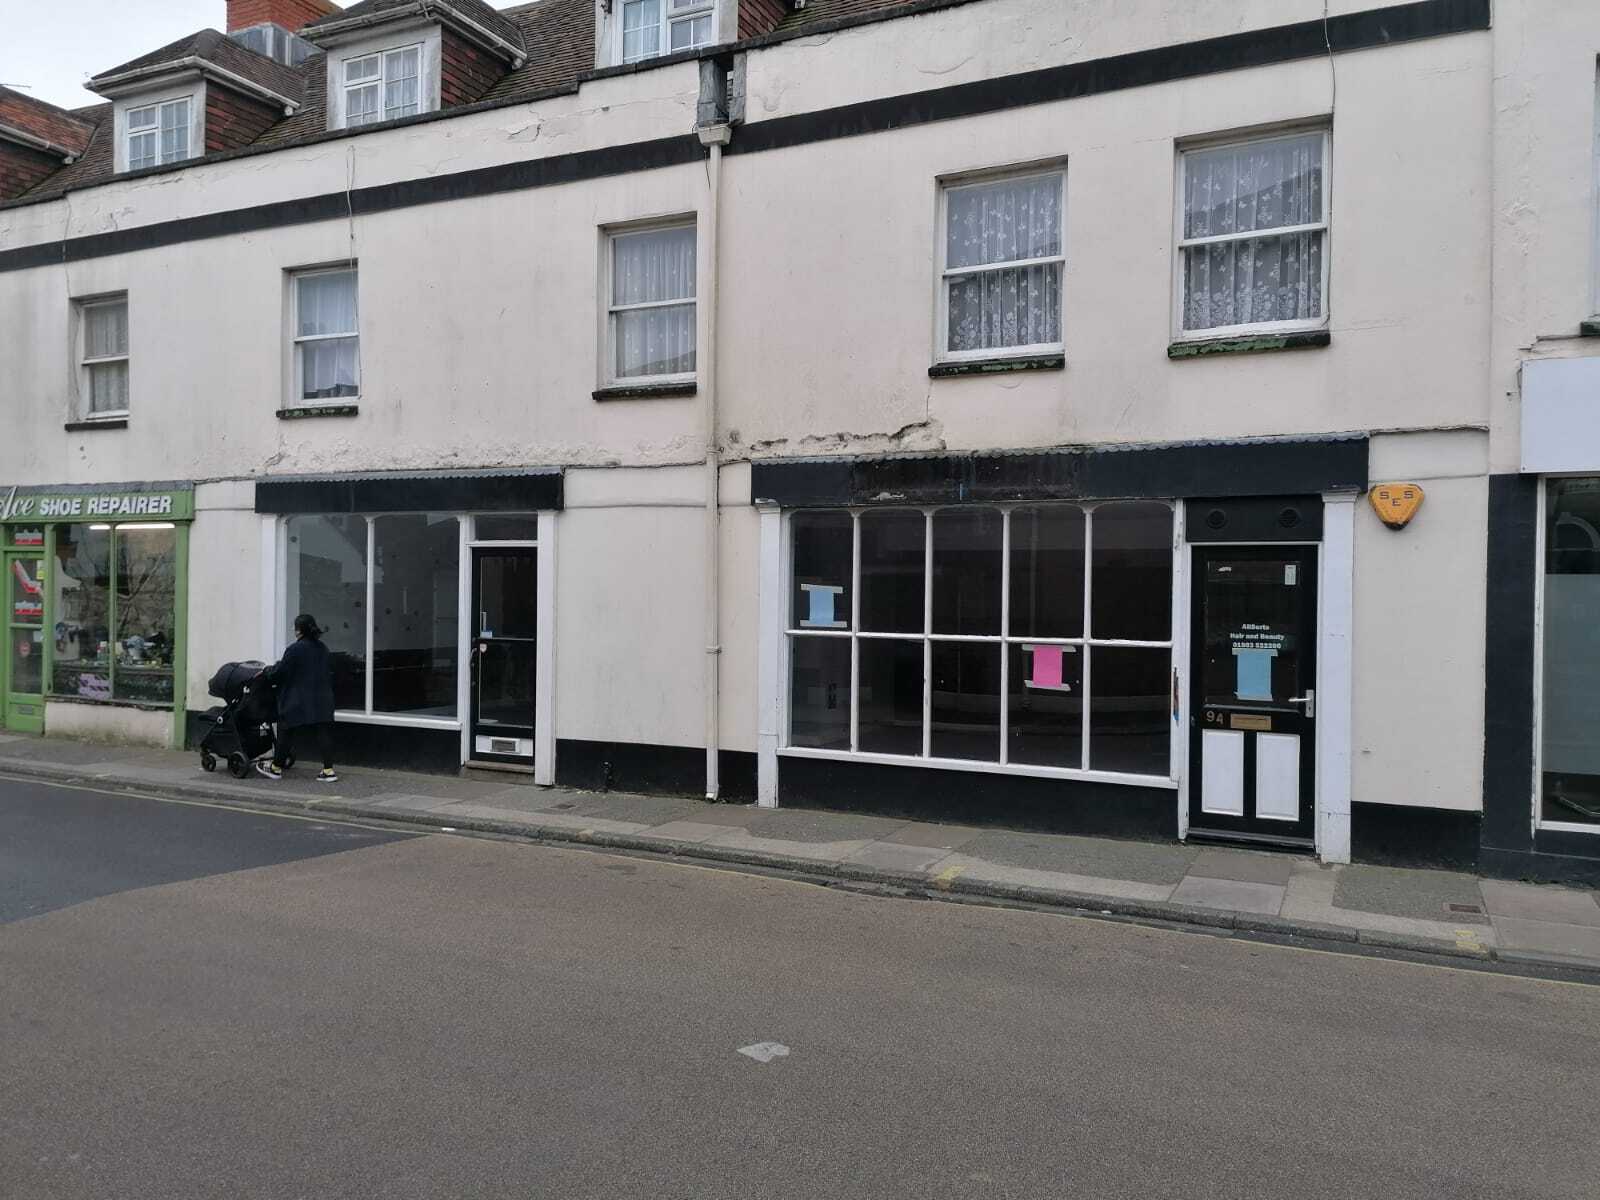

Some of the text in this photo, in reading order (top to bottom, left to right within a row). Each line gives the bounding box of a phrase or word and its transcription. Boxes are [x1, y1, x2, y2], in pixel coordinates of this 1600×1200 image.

[40, 498, 82, 515] SHOE
[87, 495, 172, 514] REPAIRER
[1260, 633, 1285, 641] Beauty
[1206, 710, 1224, 725] 94
